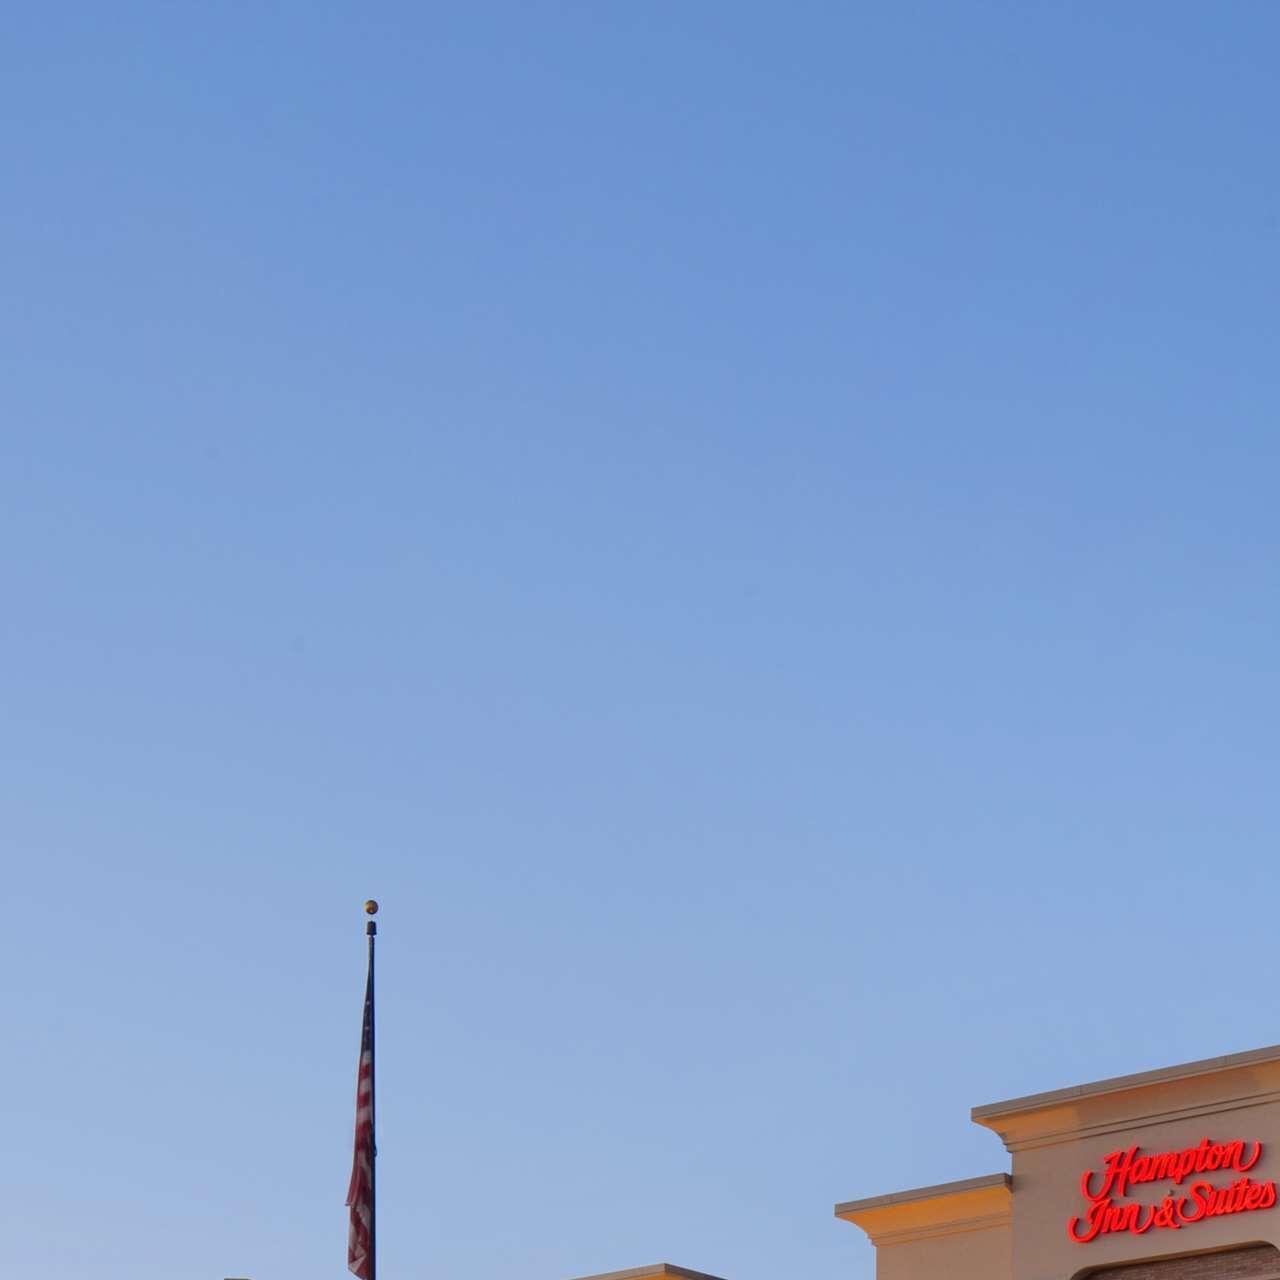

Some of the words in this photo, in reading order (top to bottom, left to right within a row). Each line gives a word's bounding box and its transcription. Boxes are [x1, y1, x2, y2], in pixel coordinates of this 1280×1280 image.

[1081, 1136, 1263, 1201] Hampton
[1068, 1198, 1157, 1244] Inn
[1154, 1194, 1181, 1229] &
[1177, 1175, 1278, 1223] Suites
